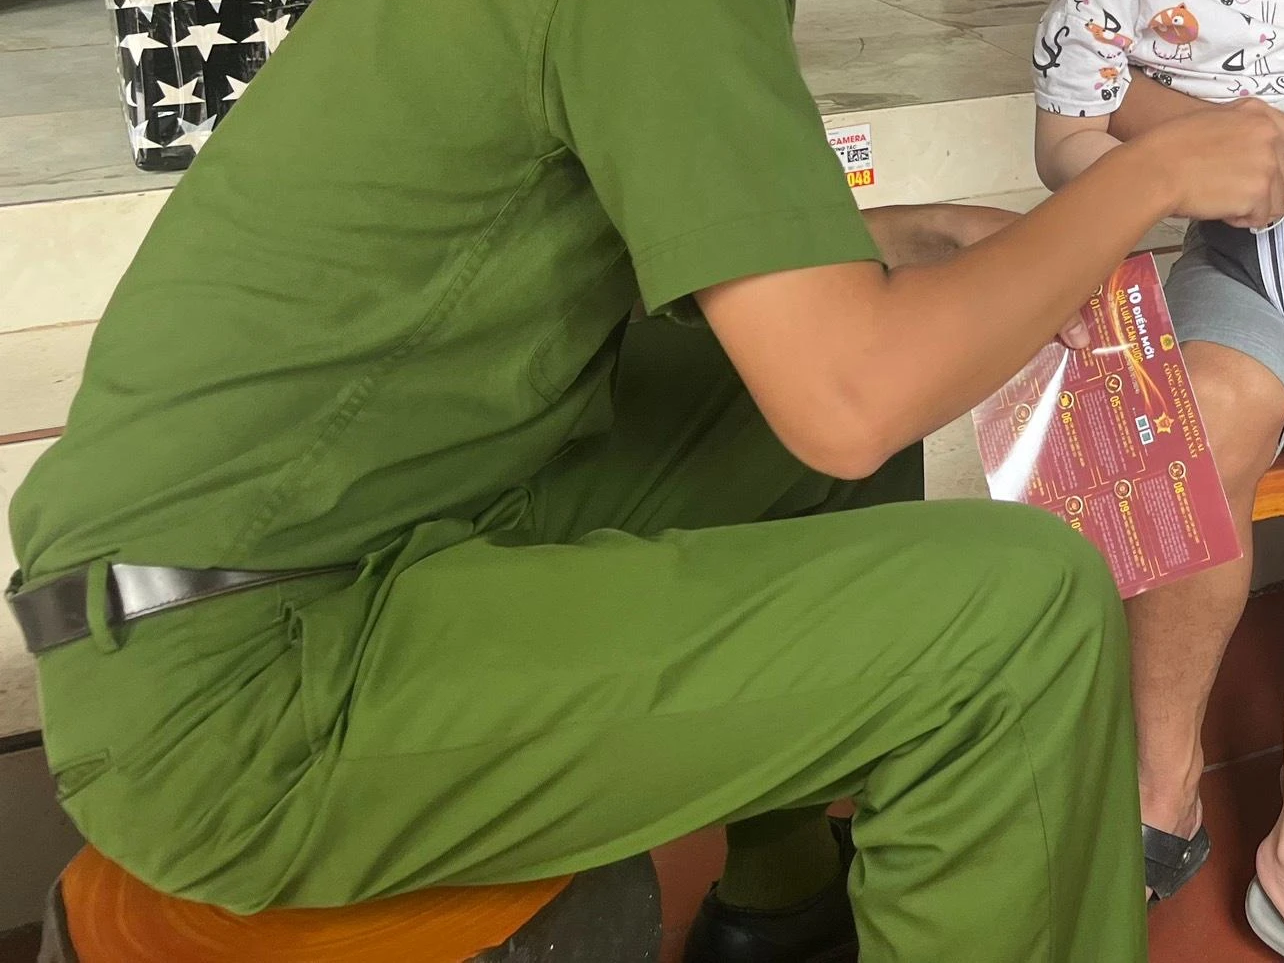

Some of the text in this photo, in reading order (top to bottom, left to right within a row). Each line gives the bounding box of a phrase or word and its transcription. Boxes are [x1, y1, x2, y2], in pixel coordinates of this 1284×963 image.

[829, 134, 867, 146] CAMERA
[847, 169, 871, 187] 048
[1127, 284, 1142, 304] 10
[1141, 336, 1155, 359] MỚI
[1110, 395, 1120, 408] 05
[1061, 411, 1072, 424] 06
[1174, 481, 1184, 494] 08
[1118, 500, 1129, 512] 09
[1070, 517, 1081, 529] 10
